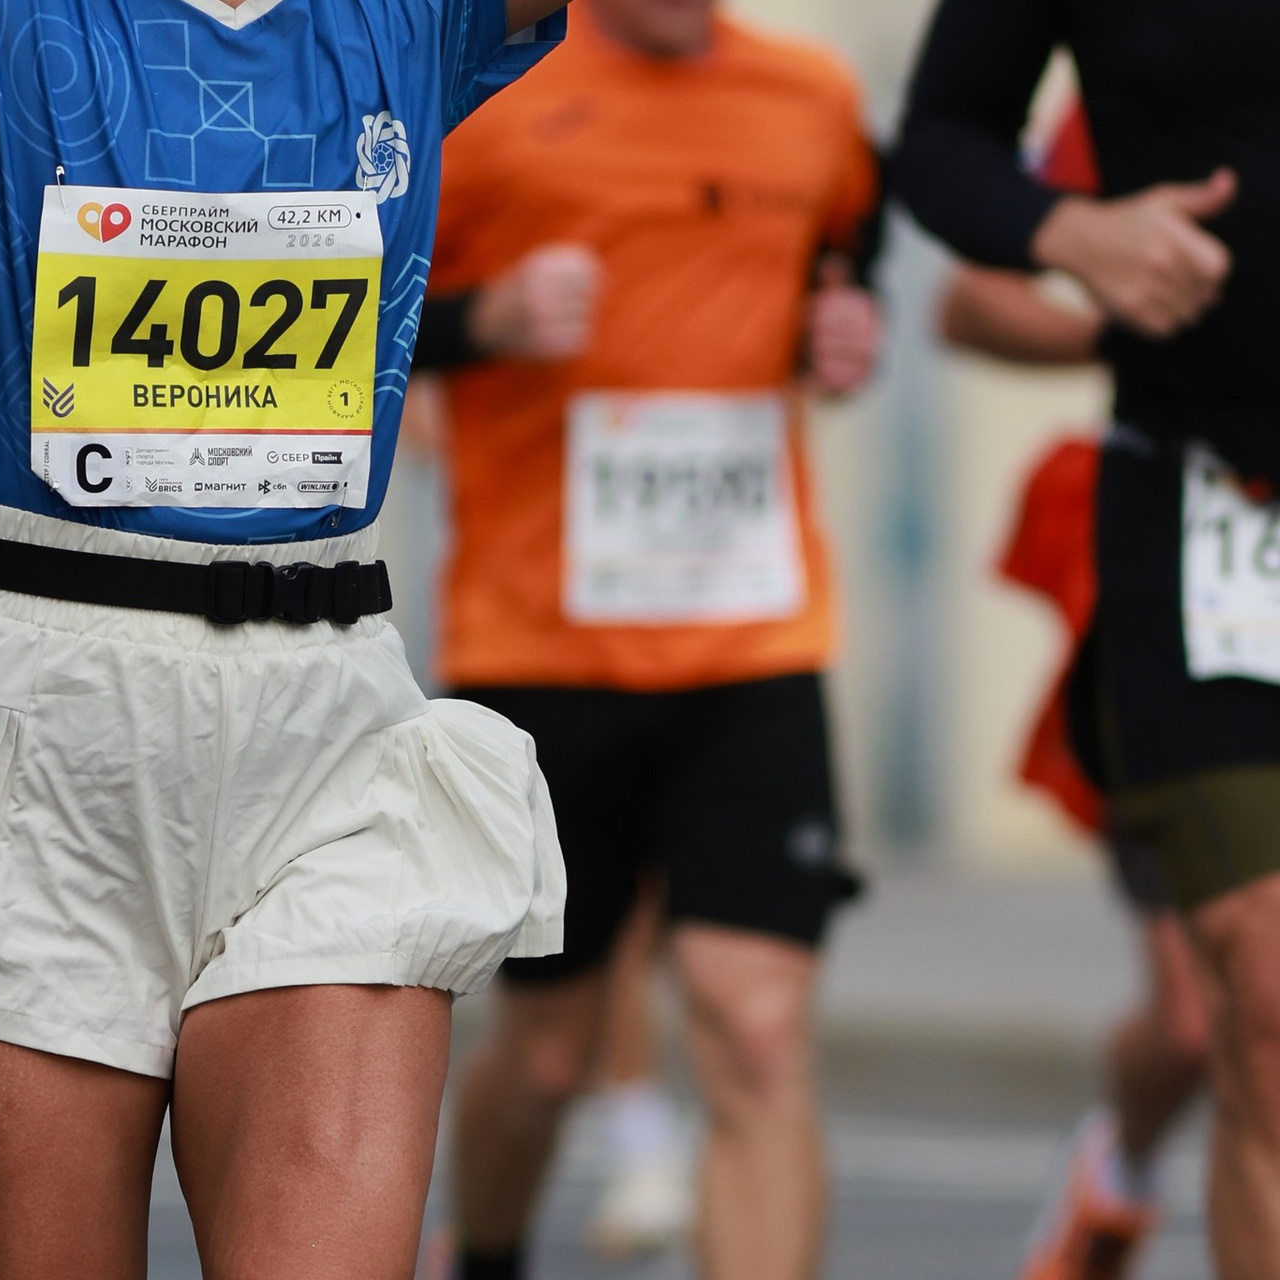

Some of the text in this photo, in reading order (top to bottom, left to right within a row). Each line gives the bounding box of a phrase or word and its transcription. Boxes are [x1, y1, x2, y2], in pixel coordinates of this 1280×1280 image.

[141, 204, 230, 218] СБЕРПРАЙМ
[277, 209, 342, 225] 42,2 КМ
[140, 218, 259, 233] МОСКОВСКИЙ
[139, 233, 228, 249] МАРАФОН
[285, 233, 335, 247] 2026
[57, 276, 368, 371] 14027
[132, 384, 278, 408] ВЕРОНИКА
[340, 392, 349, 406] 1
[207, 446, 253, 457] МОСКОВСКИЙ
[281, 453, 338, 462] СБЕР Прайм
[207, 457, 229, 466] СПОРТ
[158, 485, 183, 493] BRICS
[204, 483, 247, 491] магнит
